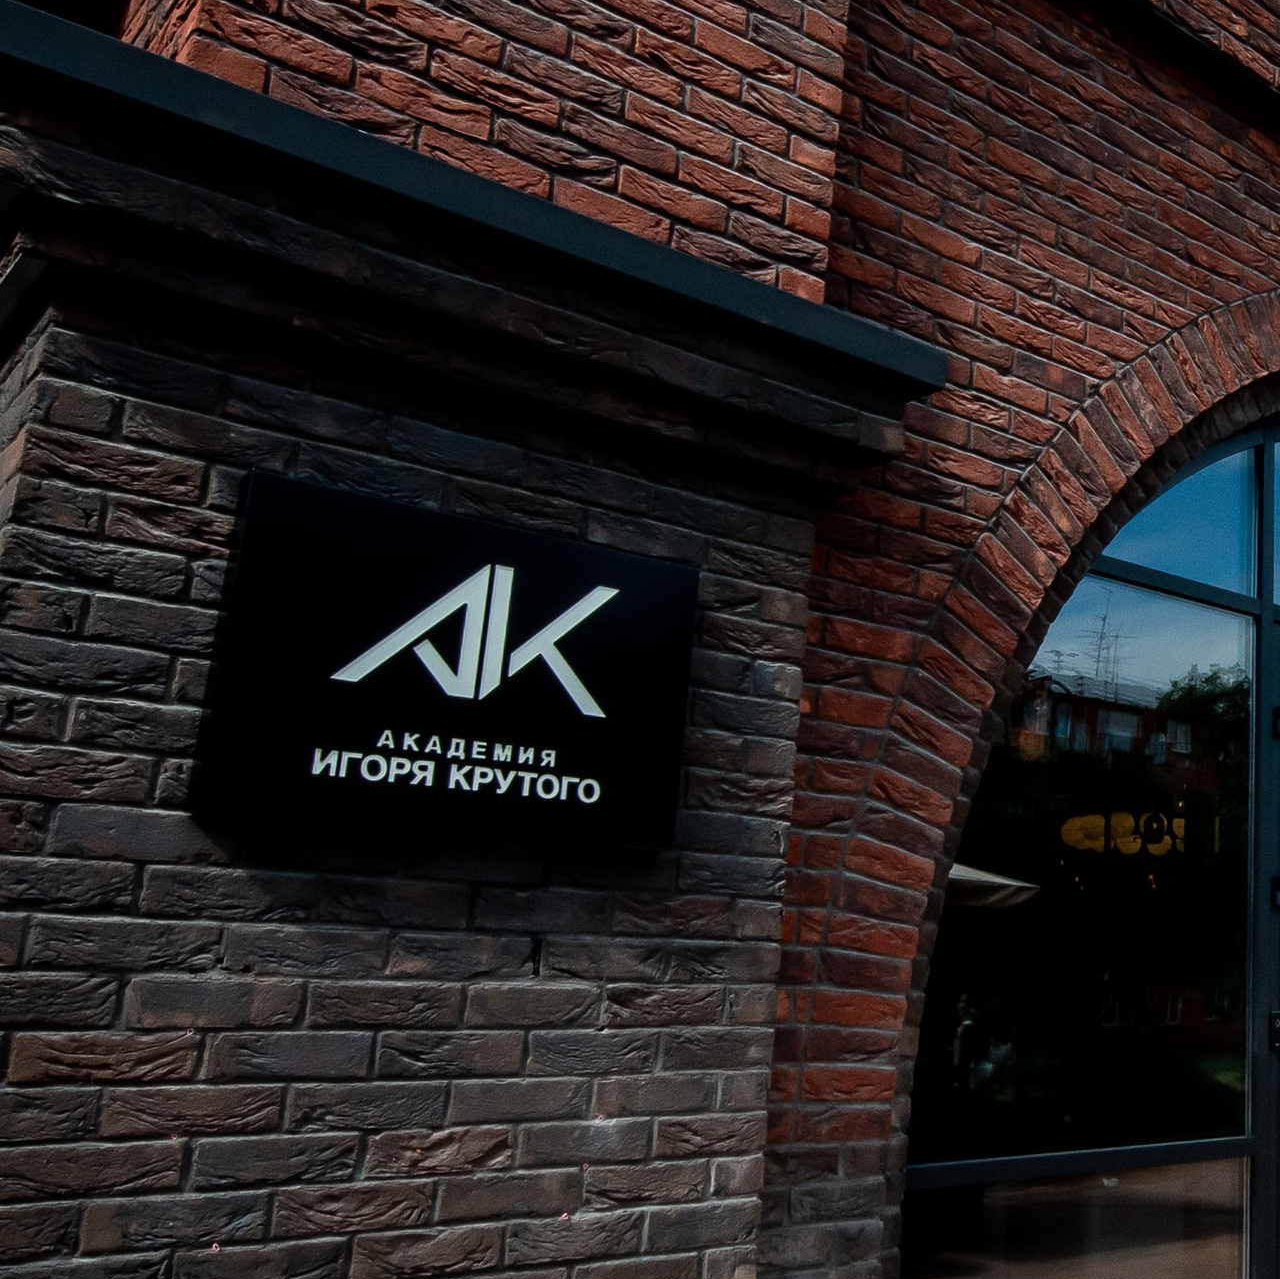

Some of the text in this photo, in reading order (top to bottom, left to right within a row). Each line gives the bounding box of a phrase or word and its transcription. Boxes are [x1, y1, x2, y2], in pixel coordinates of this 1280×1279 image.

[376, 729, 557, 768] АКАДЕМИЯ
[311, 748, 601, 804] ИГОРЯ КРУТОГО
